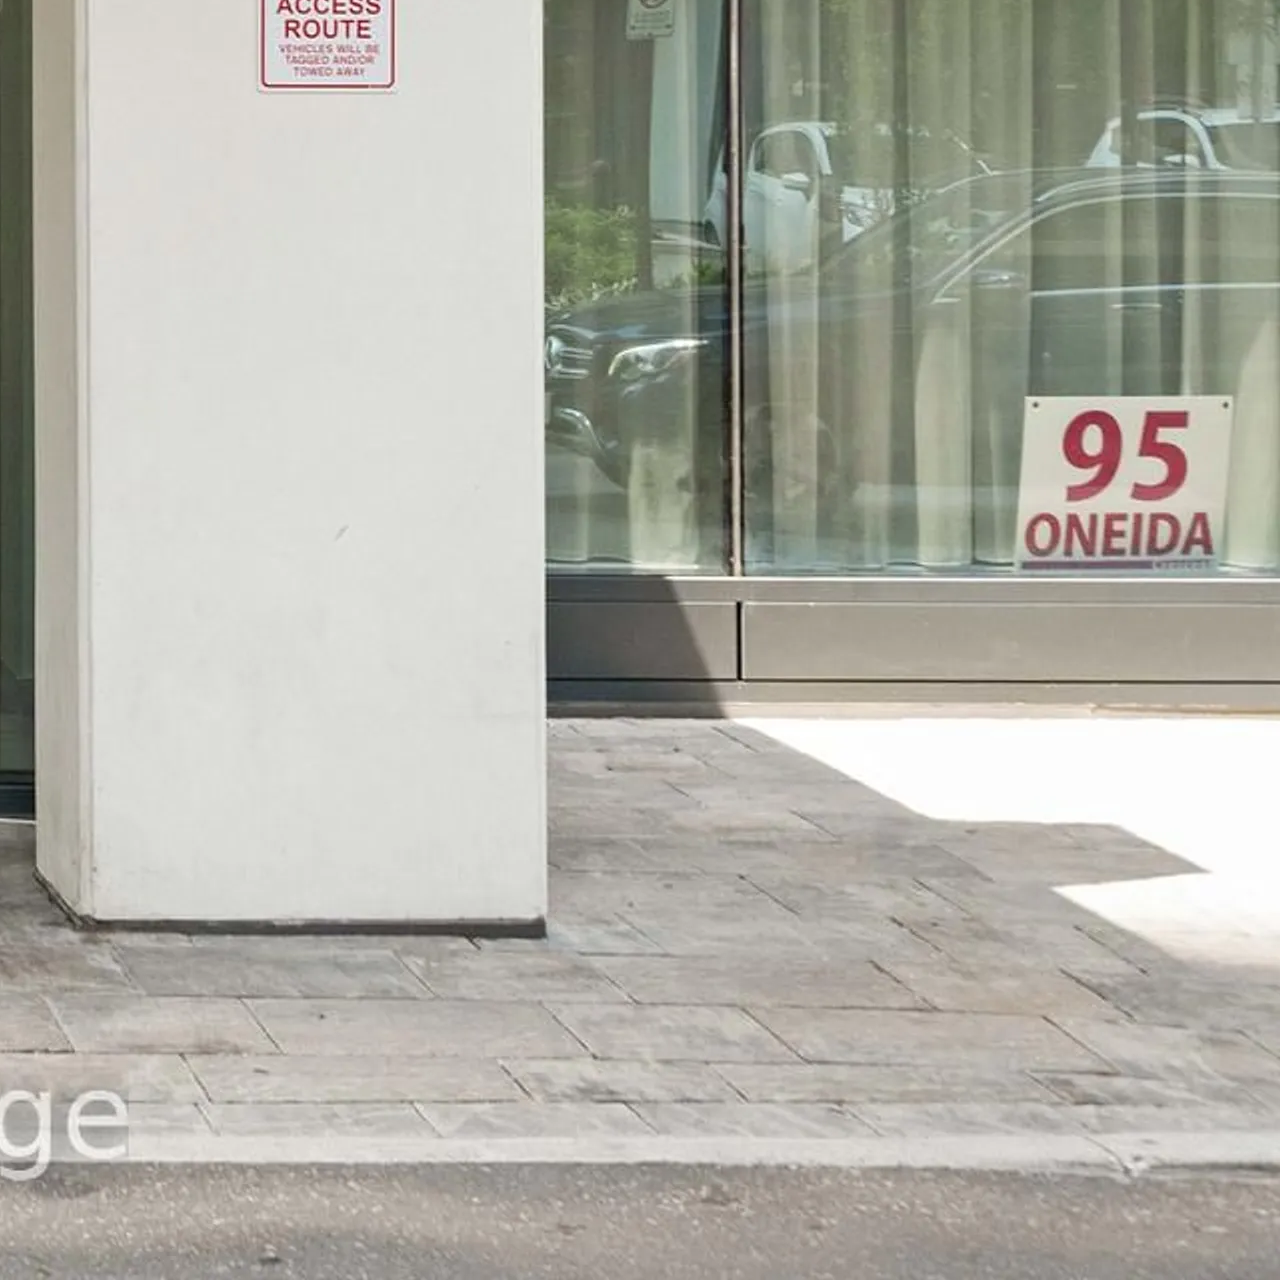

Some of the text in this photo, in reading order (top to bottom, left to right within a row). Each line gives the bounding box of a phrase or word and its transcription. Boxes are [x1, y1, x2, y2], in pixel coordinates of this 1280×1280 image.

[284, 19, 372, 39] ROUTE
[279, 43, 333, 53] VEHICLES
[336, 43, 361, 53] WILL
[286, 55, 330, 65] TAGGED
[294, 67, 365, 76] TOWED AWAY
[1061, 409, 1190, 503] 95
[1024, 511, 1214, 558] ONEIDA
